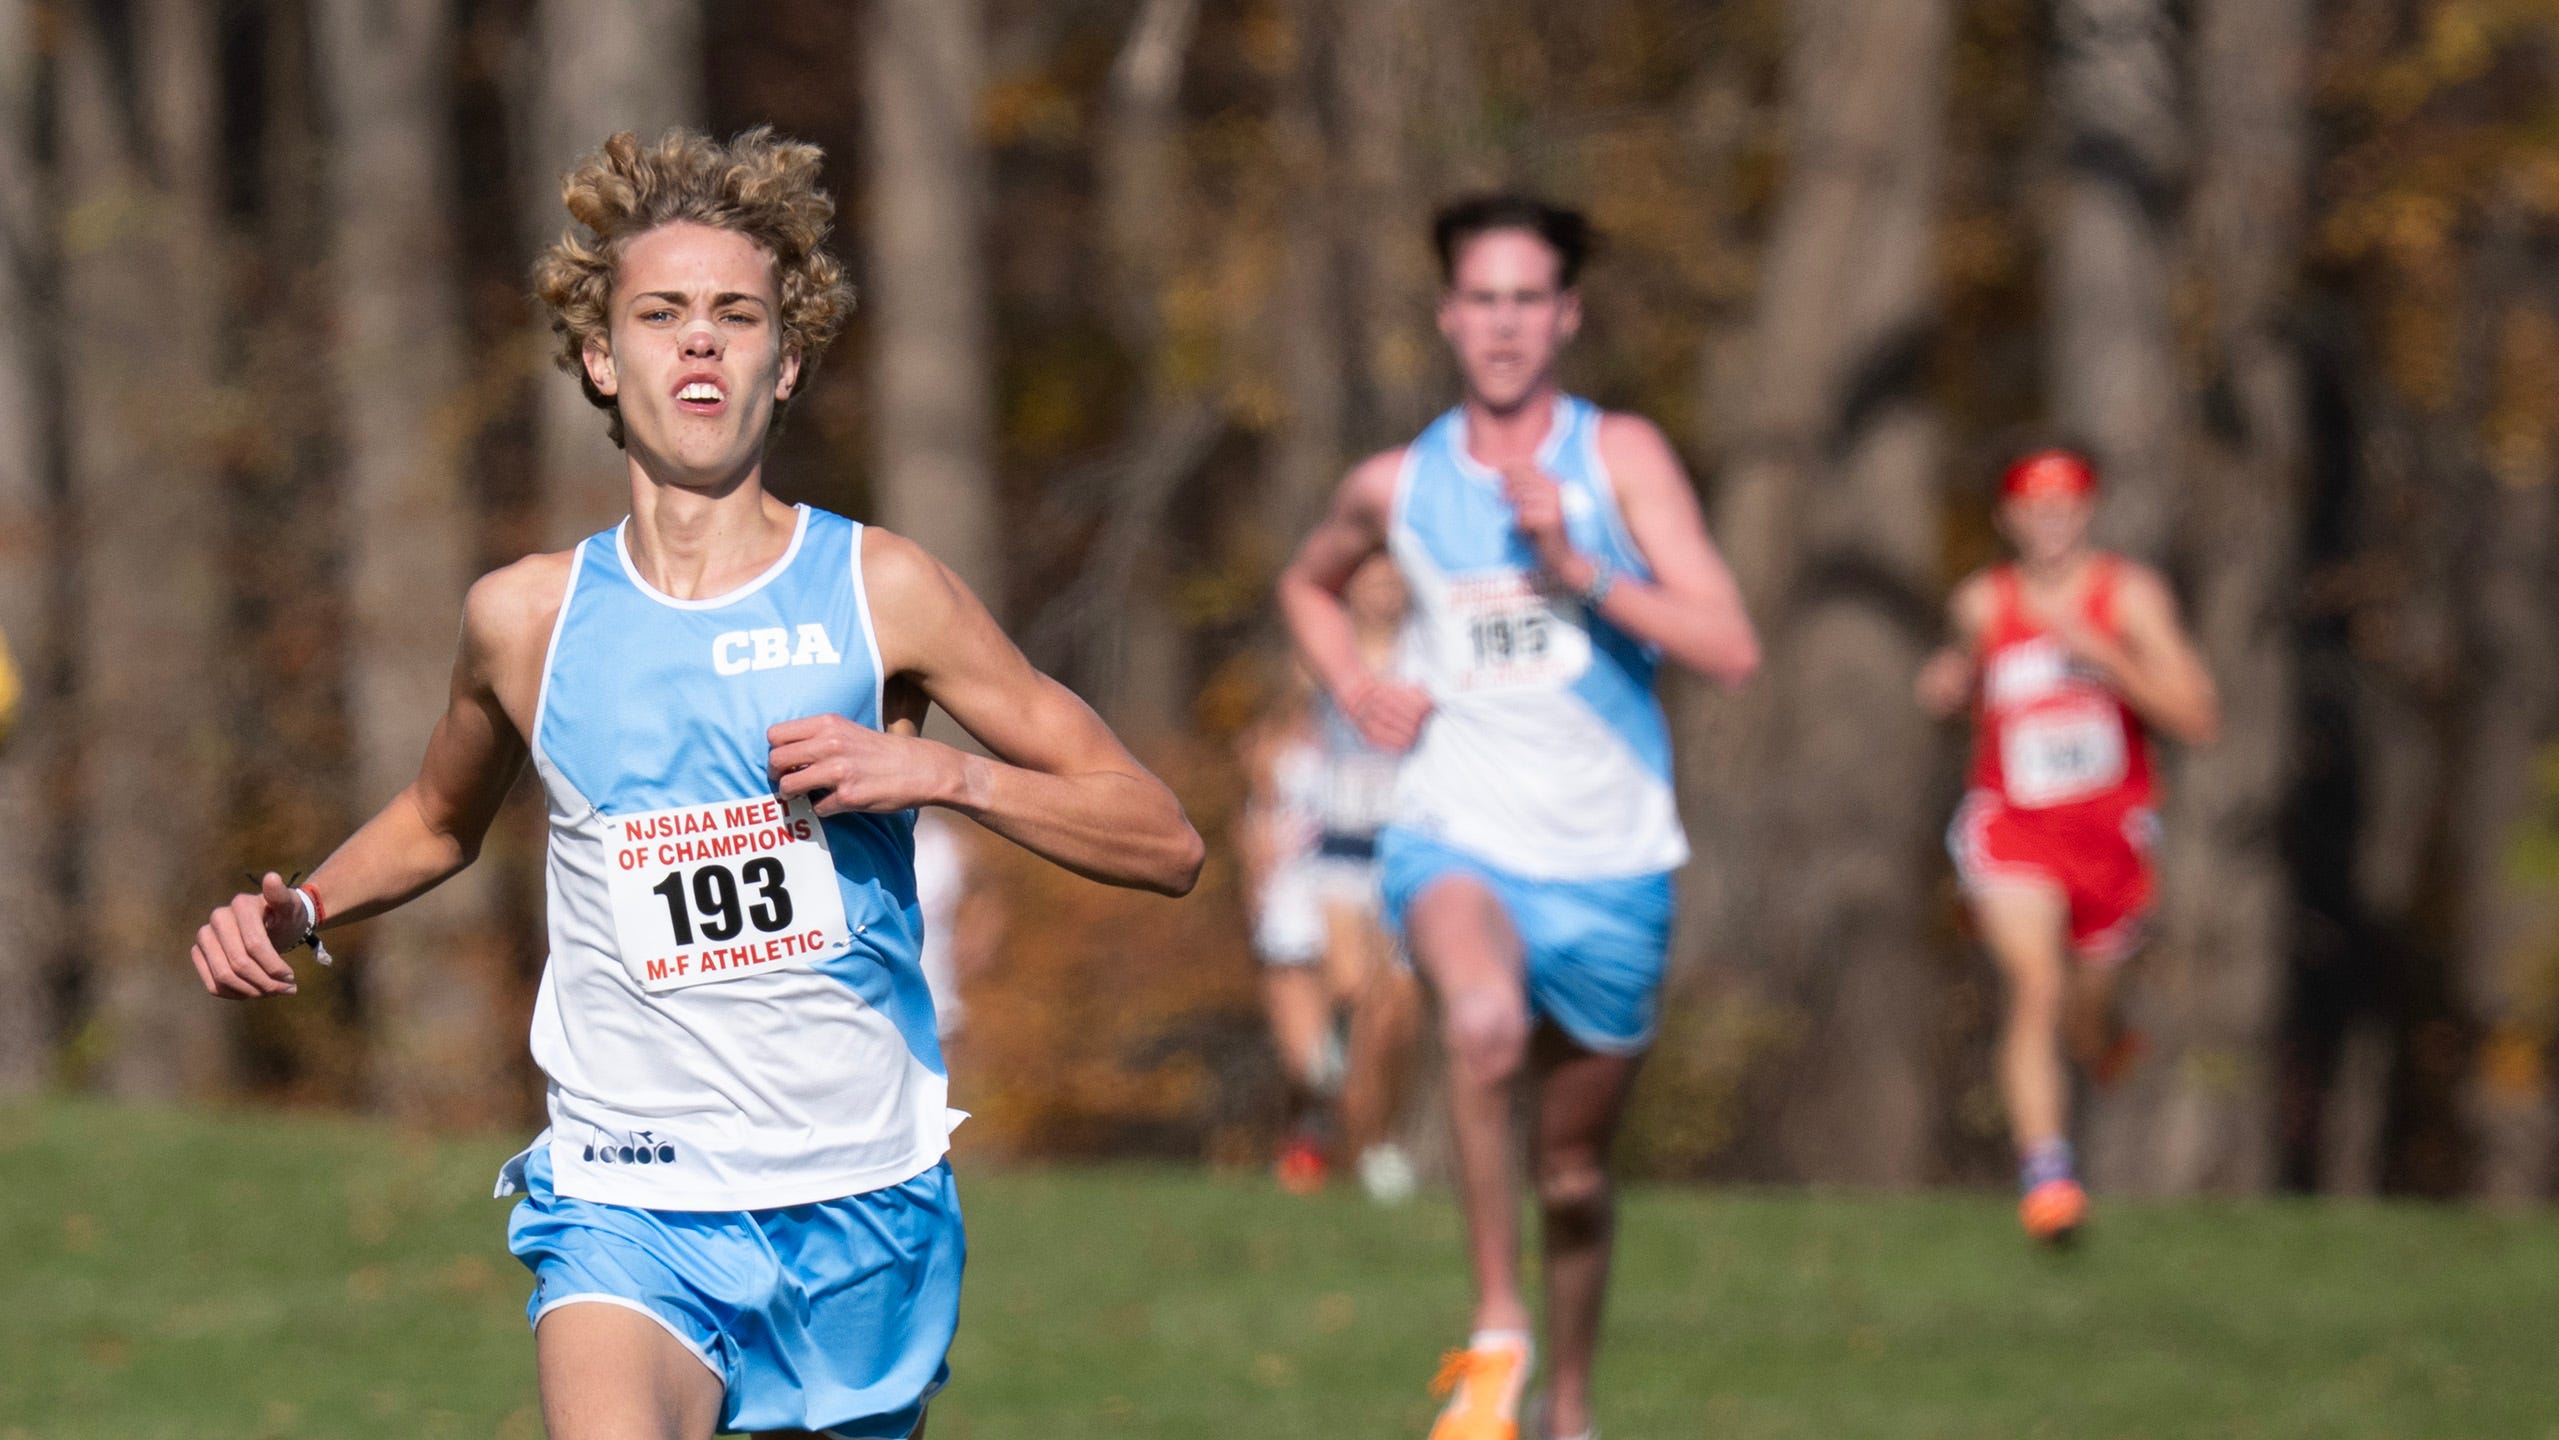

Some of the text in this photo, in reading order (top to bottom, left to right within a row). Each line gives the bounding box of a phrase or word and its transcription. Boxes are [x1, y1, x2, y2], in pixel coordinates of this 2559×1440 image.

[712, 623, 841, 676] CBA
[618, 818, 812, 870] OF CHAMPIONS
[625, 798, 791, 842] NJSIAA MEET
[653, 856, 793, 946] 193
[646, 930, 825, 981] M-F ATHLETIC
